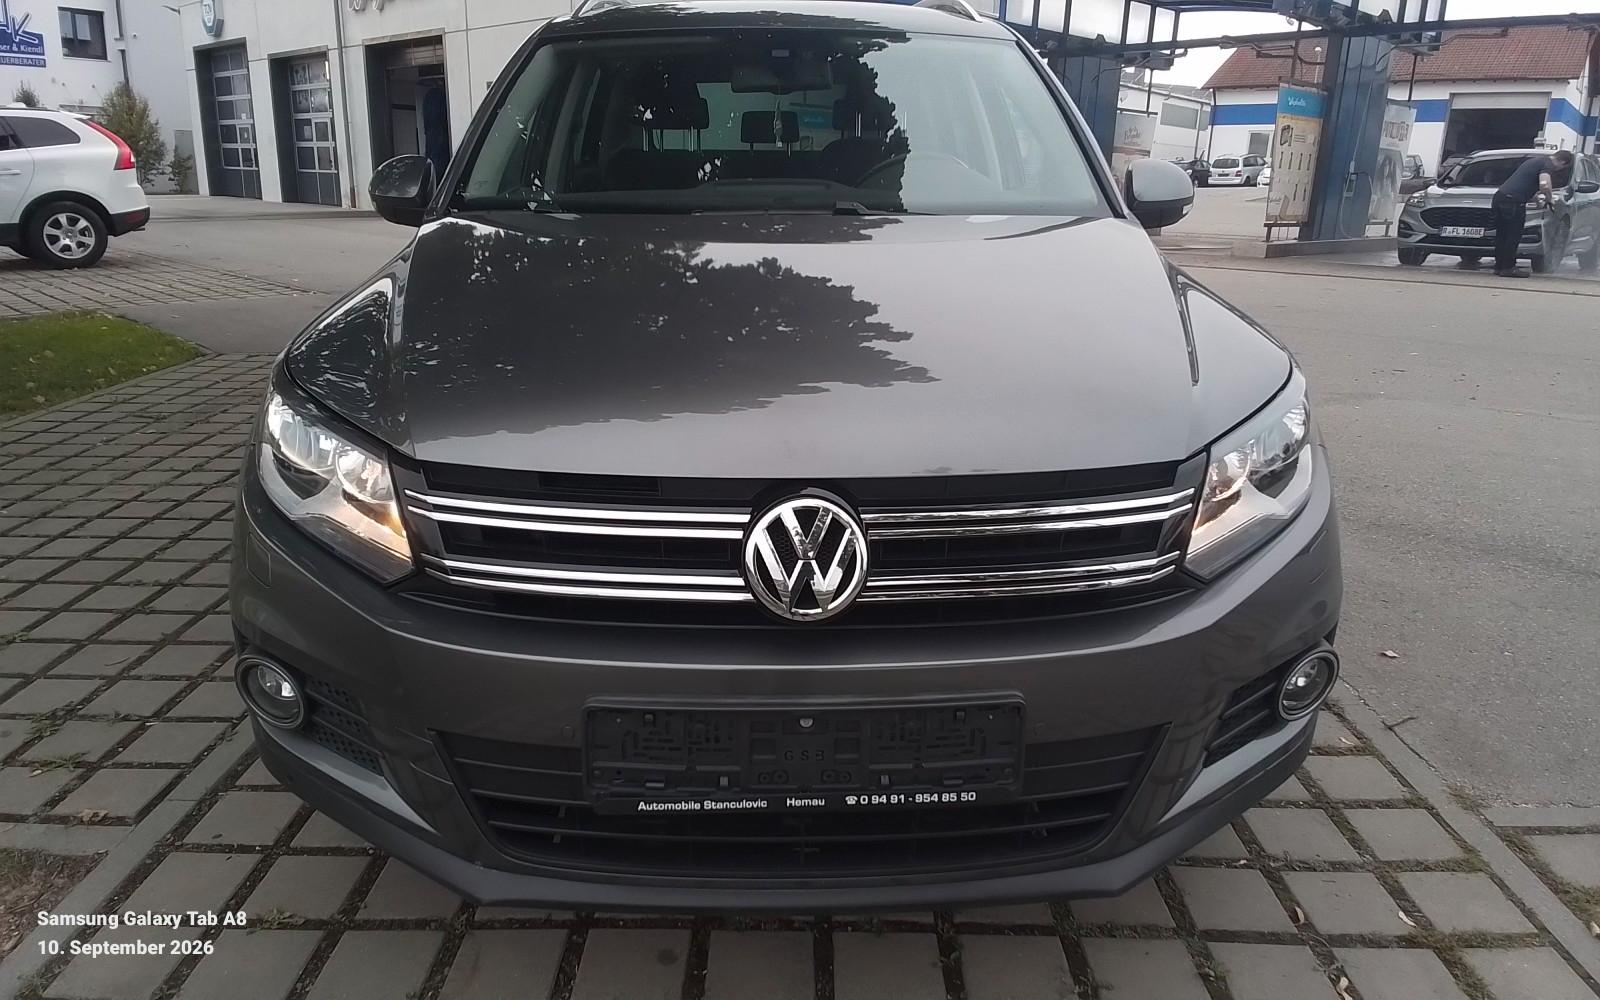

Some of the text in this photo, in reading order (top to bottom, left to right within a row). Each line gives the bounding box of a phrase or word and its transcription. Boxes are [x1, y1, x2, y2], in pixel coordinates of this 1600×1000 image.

[0, 57, 45, 66] UERBERATER
[638, 801, 701, 811] Automobile
[703, 799, 768, 810] Stanculovic
[786, 797, 825, 807] Hemau
[860, 795, 868, 805] 0
[871, 794, 887, 804] 94
[890, 794, 905, 804] 91
[915, 793, 938, 803] 954
[941, 792, 958, 802] 85
[960, 792, 976, 801] 50
